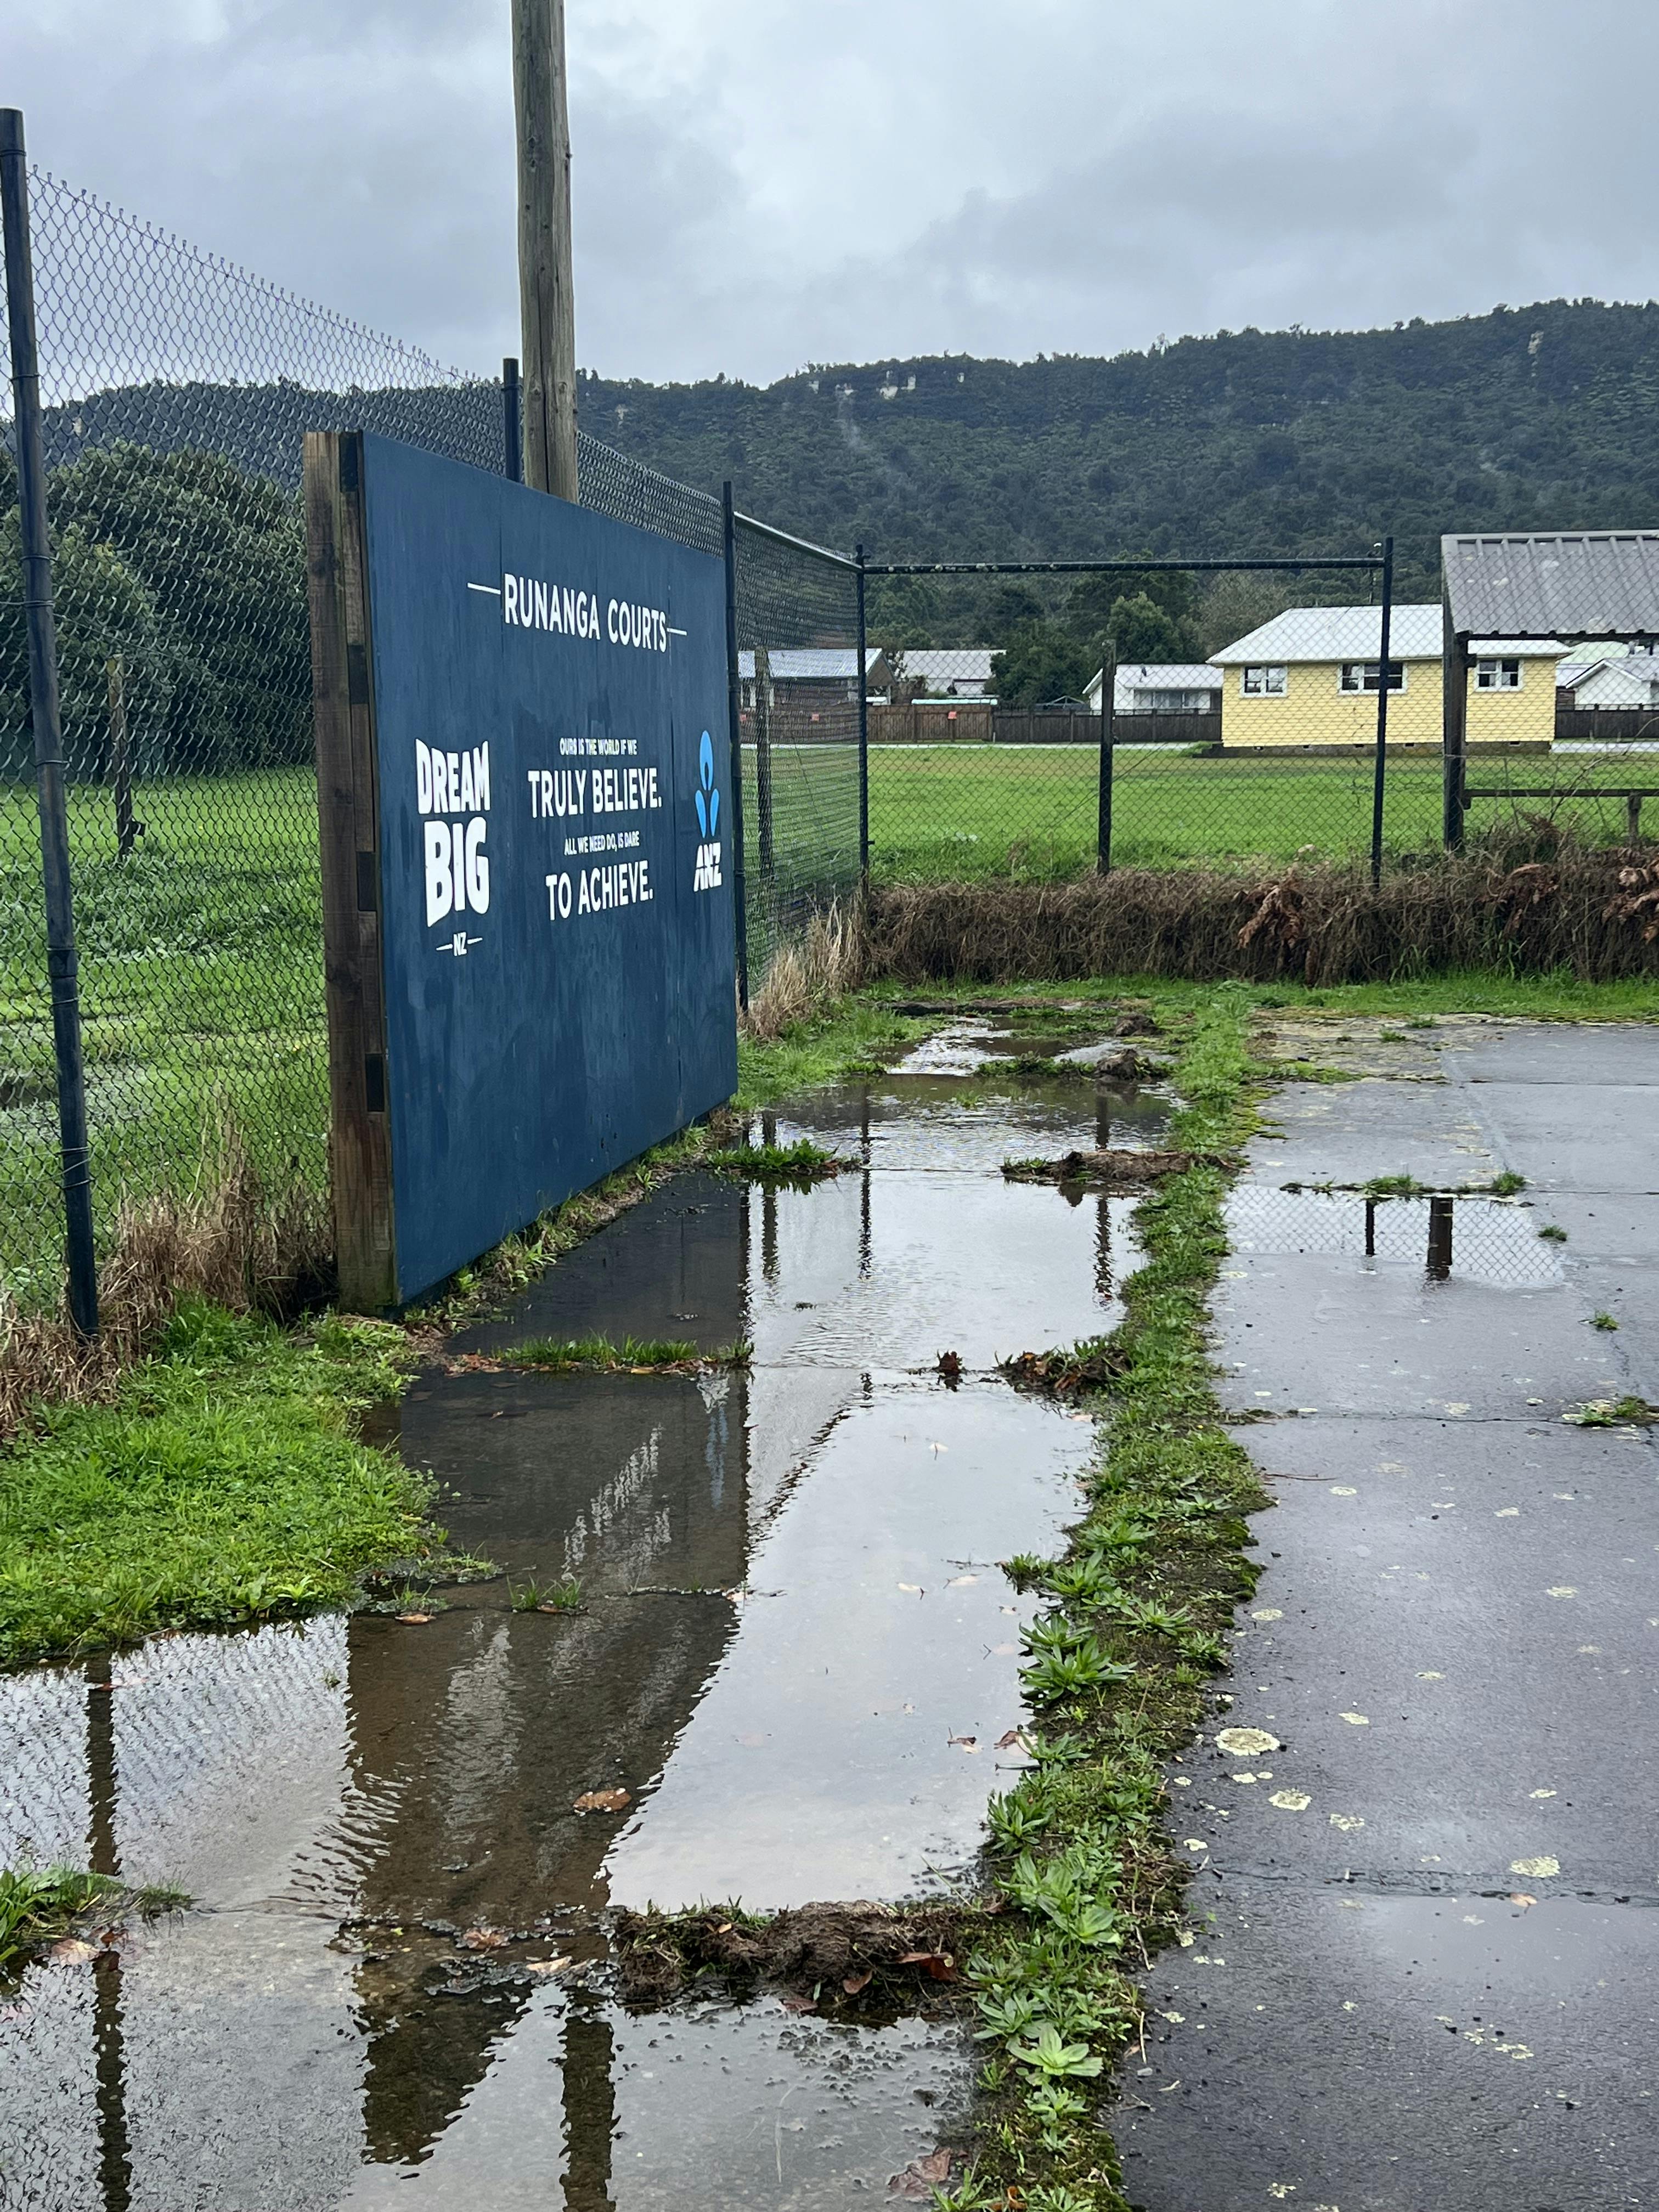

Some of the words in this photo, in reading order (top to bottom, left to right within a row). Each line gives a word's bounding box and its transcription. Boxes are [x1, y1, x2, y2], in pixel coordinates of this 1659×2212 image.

[504, 573, 601, 640] RUNANGA
[607, 599, 667, 653] COURTS
[560, 737, 577, 755] OURS
[578, 738, 584, 755] IS
[585, 738, 597, 755] THE
[597, 738, 619, 755] WORLD
[620, 739, 627, 755] IF
[627, 739, 637, 755] WE
[415, 738, 490, 814] DREAM
[528, 769, 586, 818] TRULY
[592, 768, 662, 814] BELIEVE.
[564, 838, 577, 856] ALL
[577, 836, 589, 854] WE
[589, 834, 606, 853] NEED
[606, 833, 617, 852] DO,
[617, 832, 624, 849] IS
[624, 830, 640, 848] DARE
[693, 842, 722, 892] ANZ
[424, 816, 489, 927] BIG
[545, 872, 572, 921] TO
[578, 860, 653, 915] ACHIEVE.
[453, 932, 467, 956] NZ
